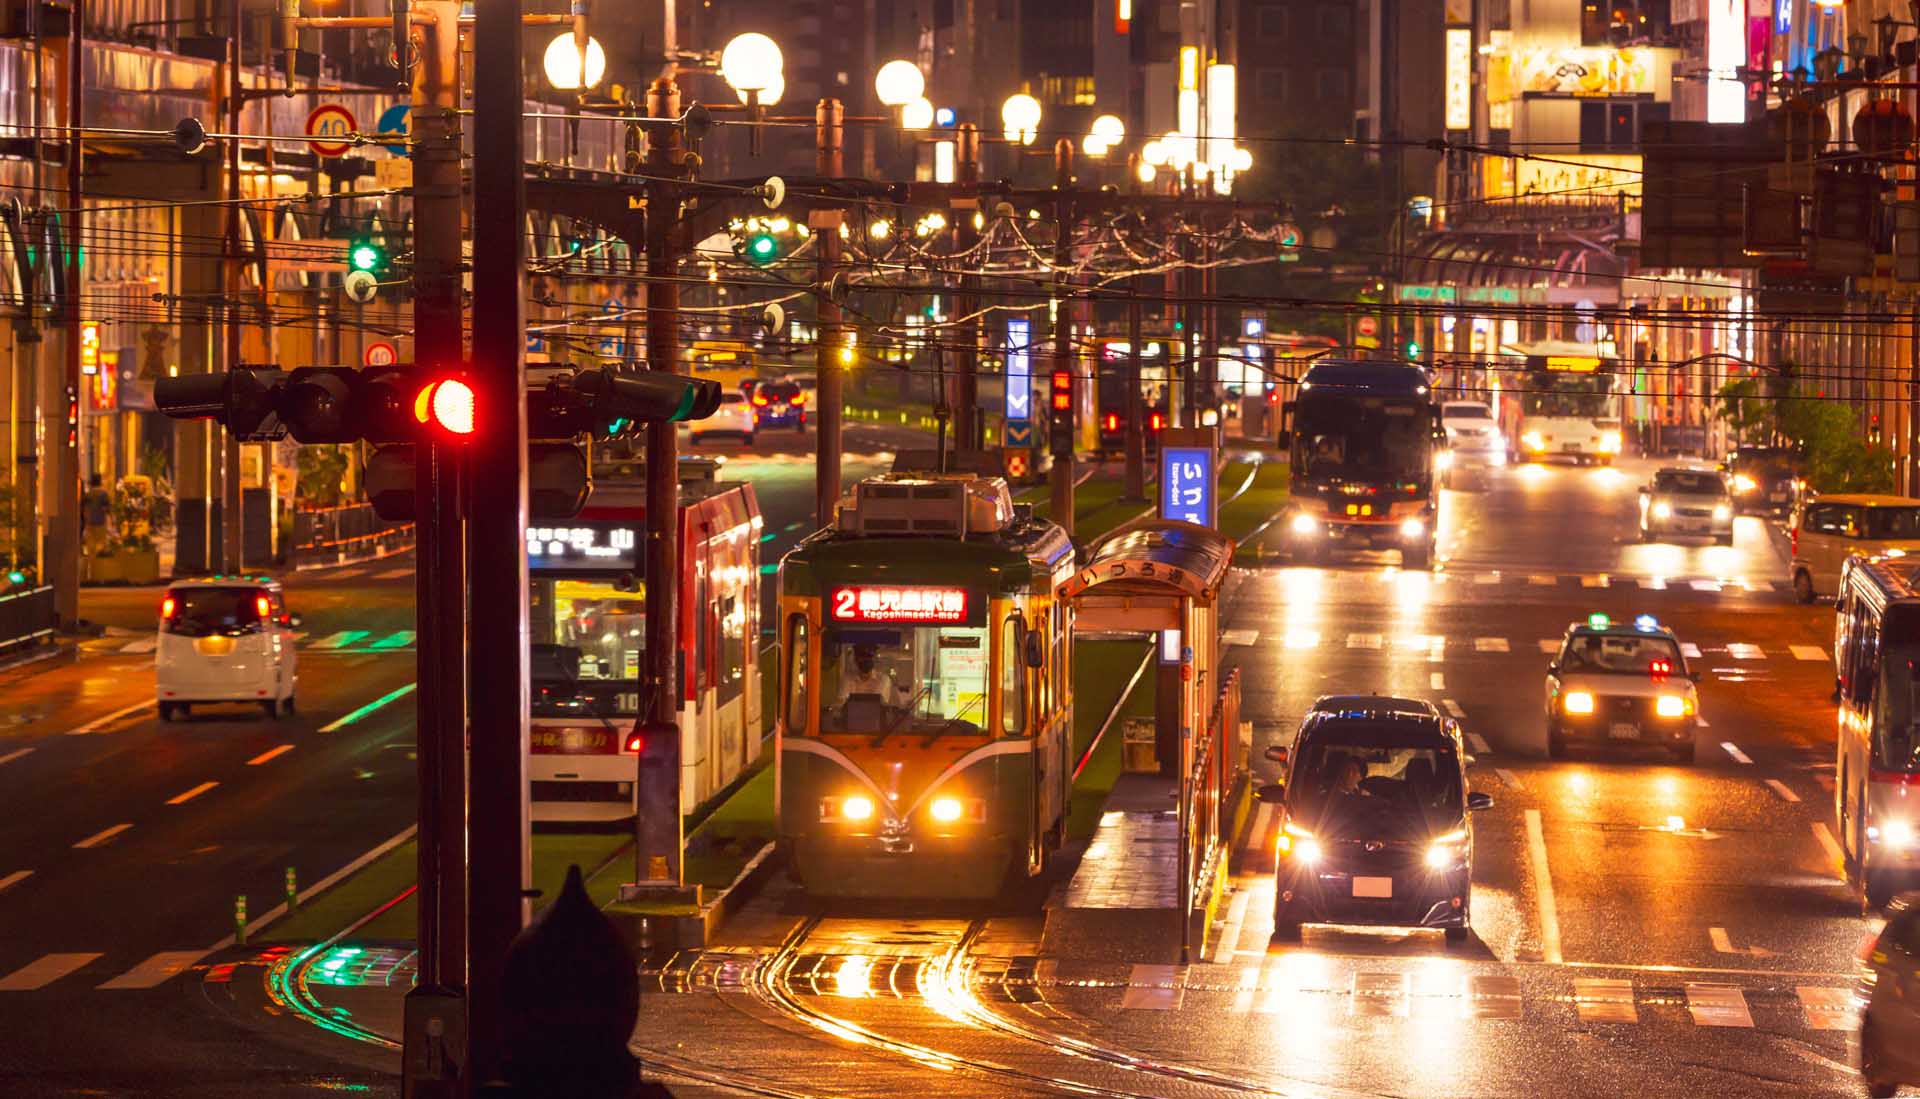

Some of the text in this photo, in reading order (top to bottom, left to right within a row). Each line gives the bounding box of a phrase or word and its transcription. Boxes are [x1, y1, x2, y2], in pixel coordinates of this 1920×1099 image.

[319, 119, 346, 137] 40
[373, 350, 390, 364] 40
[836, 590, 856, 618] 2
